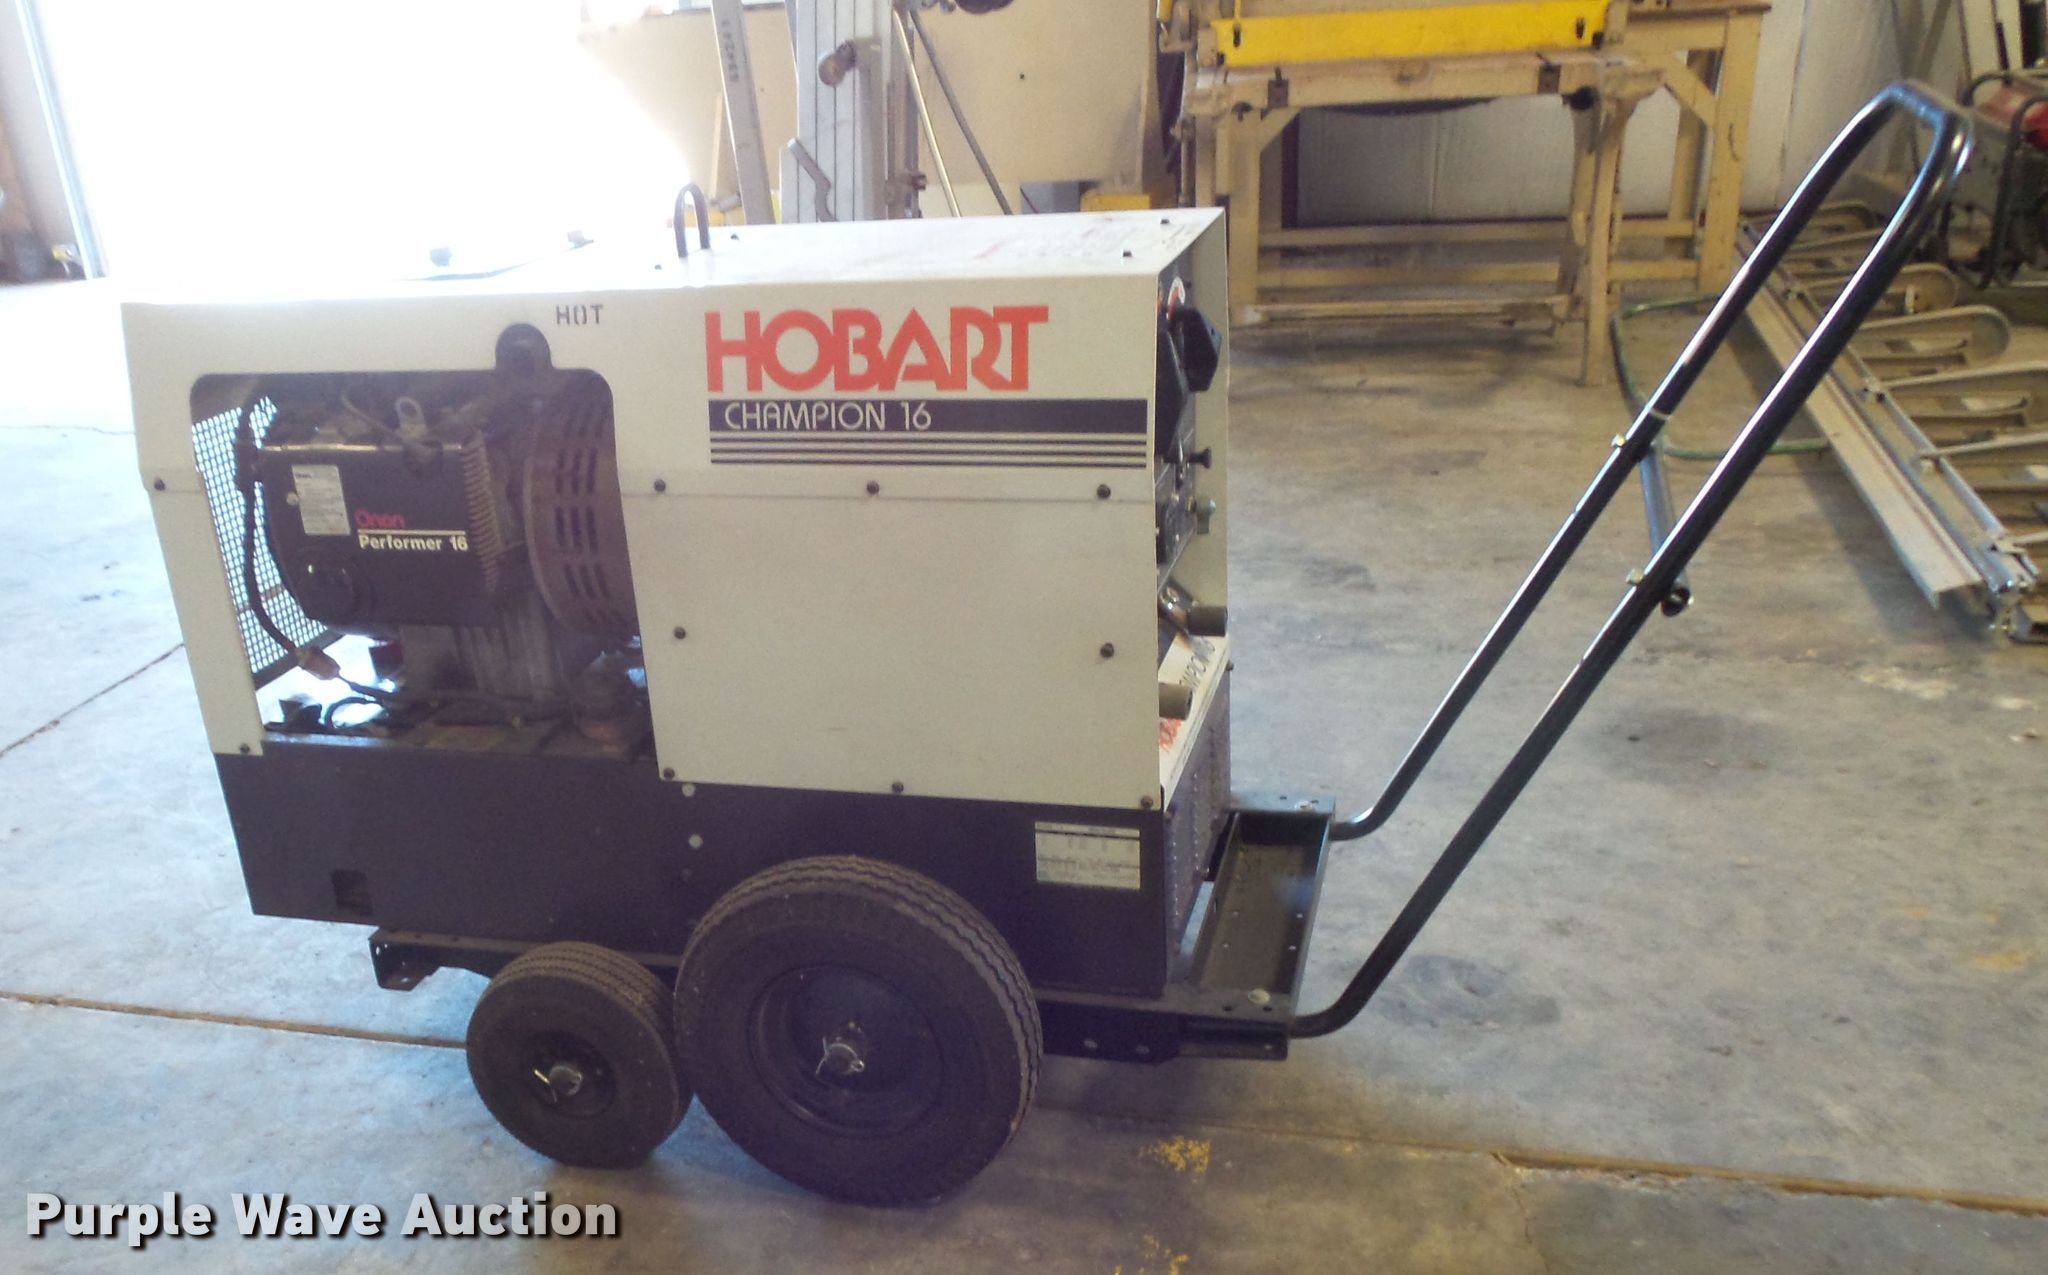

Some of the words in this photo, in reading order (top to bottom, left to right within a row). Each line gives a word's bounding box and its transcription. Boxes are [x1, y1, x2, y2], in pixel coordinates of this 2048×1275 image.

[556, 304, 603, 326] HOT
[705, 305, 1049, 392] HOBART
[724, 401, 886, 431] CHAMPION
[901, 402, 932, 431] 16
[358, 535, 443, 550] Performer
[450, 535, 469, 551] 16
